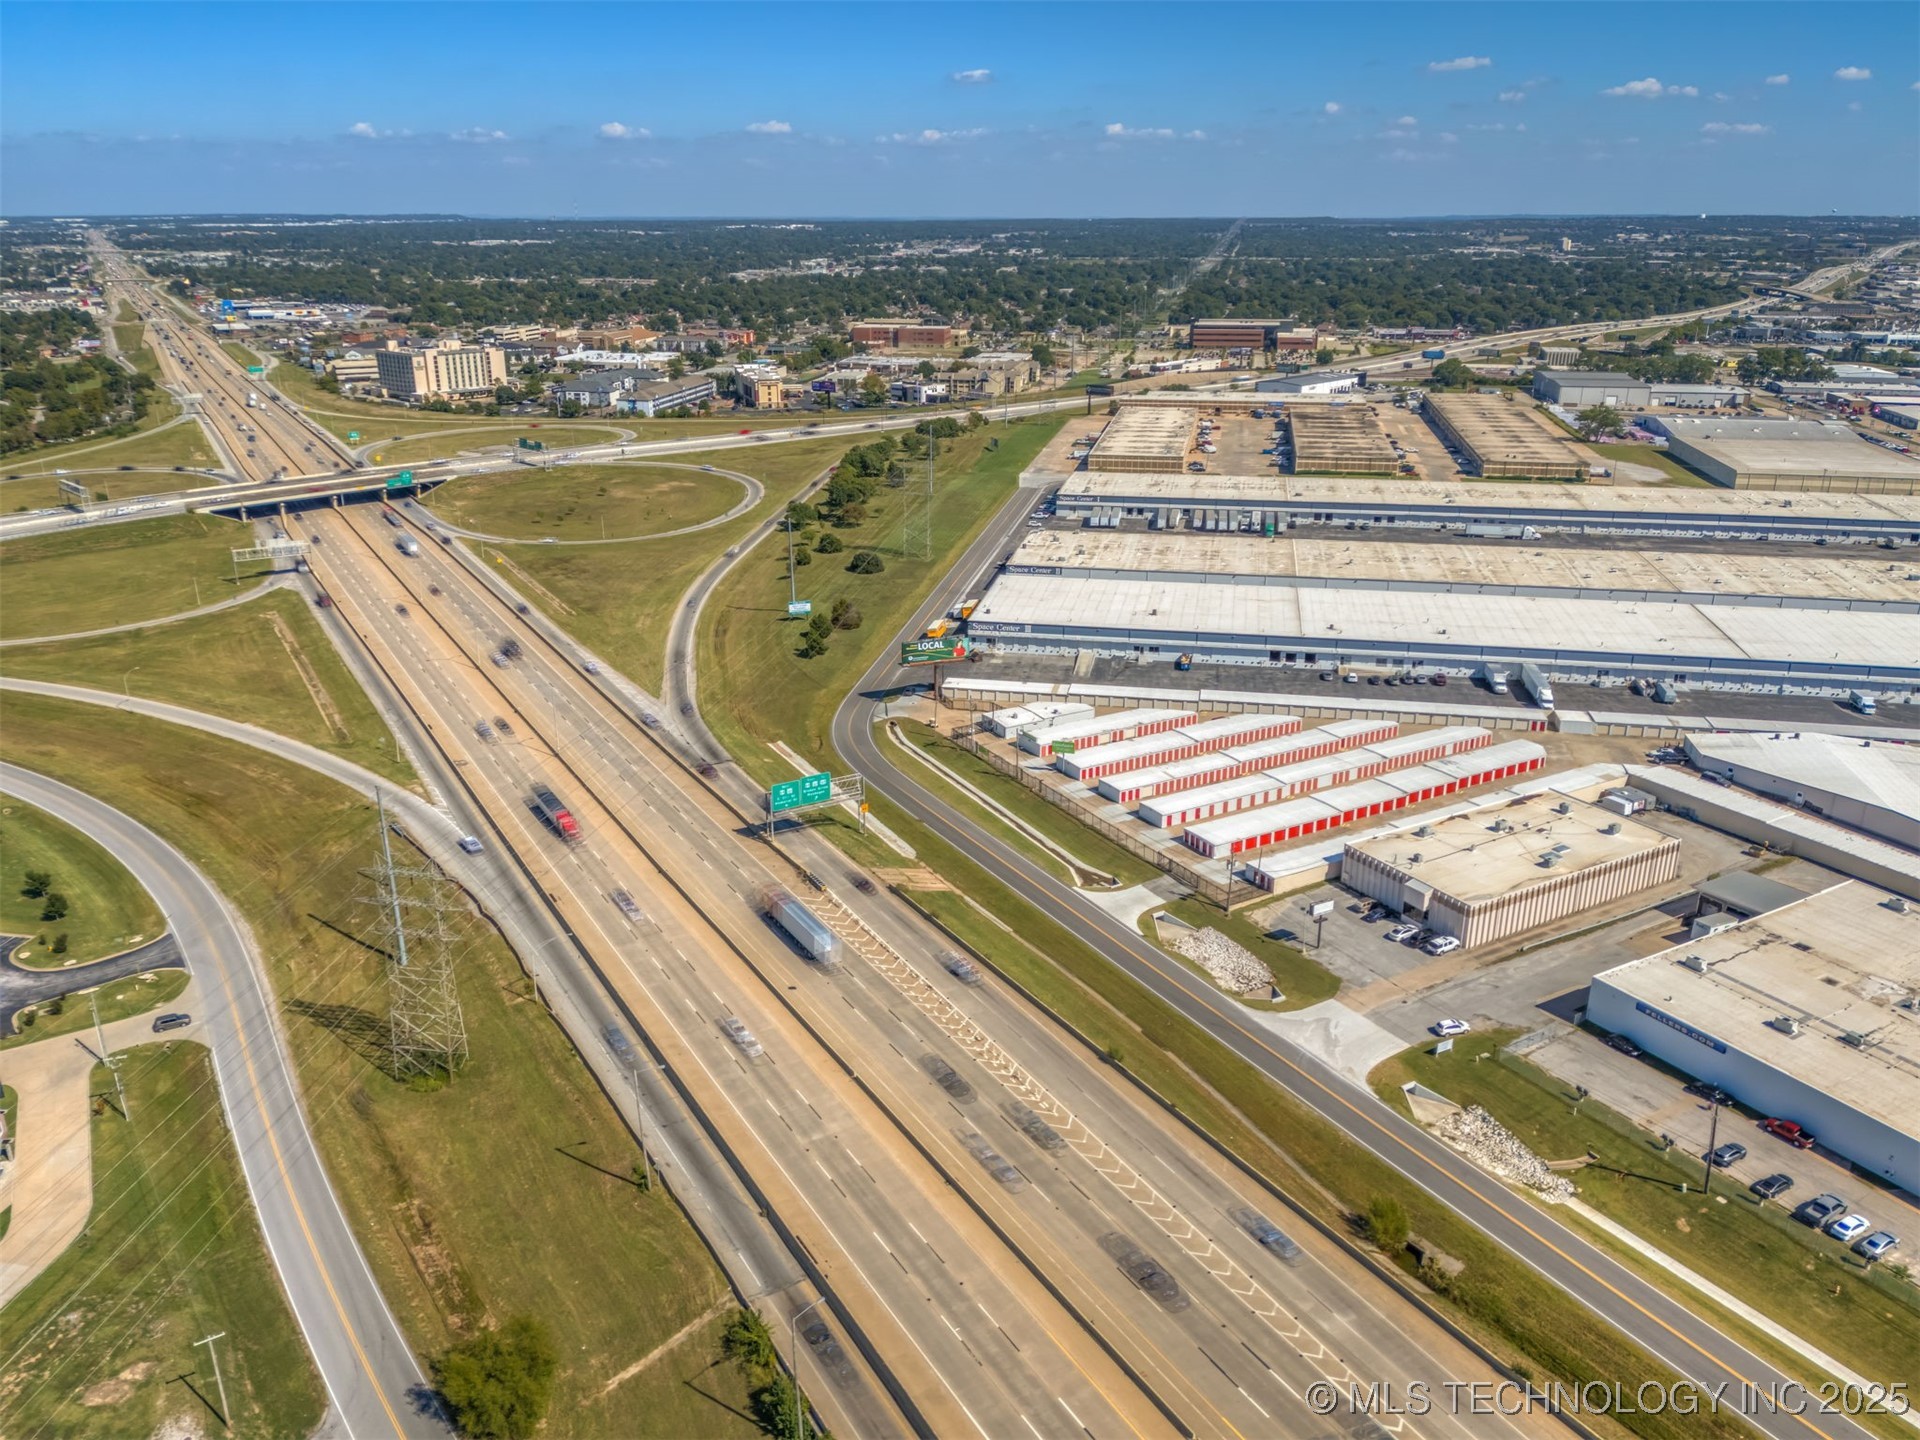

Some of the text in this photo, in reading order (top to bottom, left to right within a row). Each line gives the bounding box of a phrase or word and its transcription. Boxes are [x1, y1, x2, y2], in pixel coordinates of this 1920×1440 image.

[1030, 566, 1052, 574] Center
[972, 622, 995, 631] Space
[996, 623, 1020, 632] Center
[917, 640, 945, 651] LOCAL
[1645, 1009, 1714, 1048] FELLERS.COM
